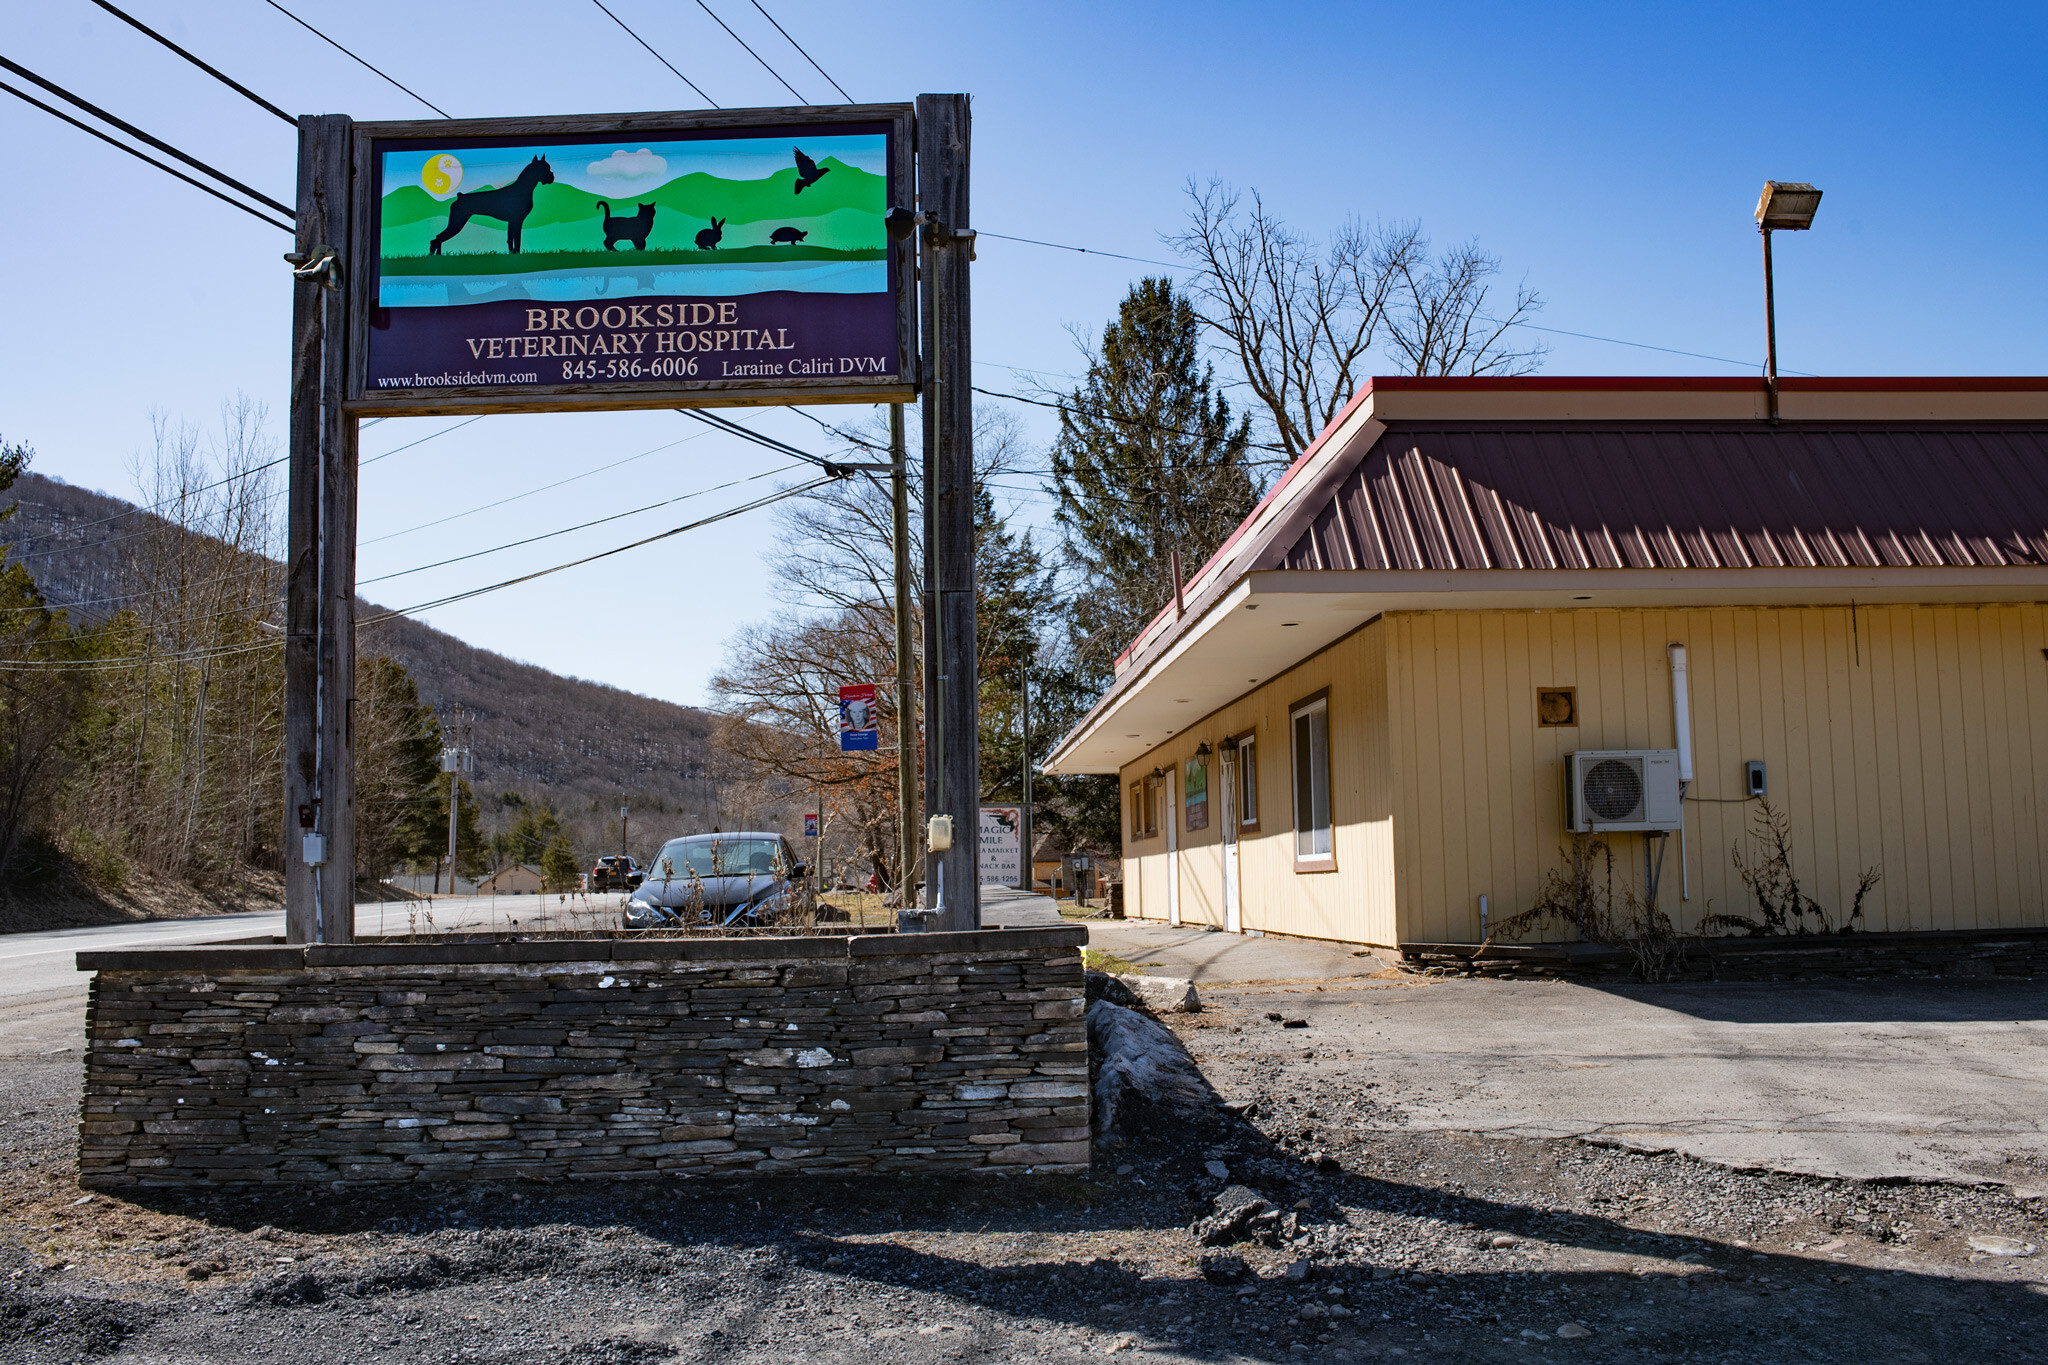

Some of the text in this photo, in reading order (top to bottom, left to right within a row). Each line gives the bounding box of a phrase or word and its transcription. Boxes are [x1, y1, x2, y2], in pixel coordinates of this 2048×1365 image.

[525, 302, 739, 331] BROOKSIDE
[466, 328, 795, 359] VETERINARY HOSPITAL
[562, 356, 699, 380] 845-586-6006
[721, 356, 887, 377] Laraine Caliri DVM
[377, 370, 538, 388] www.brooksidedvm.com
